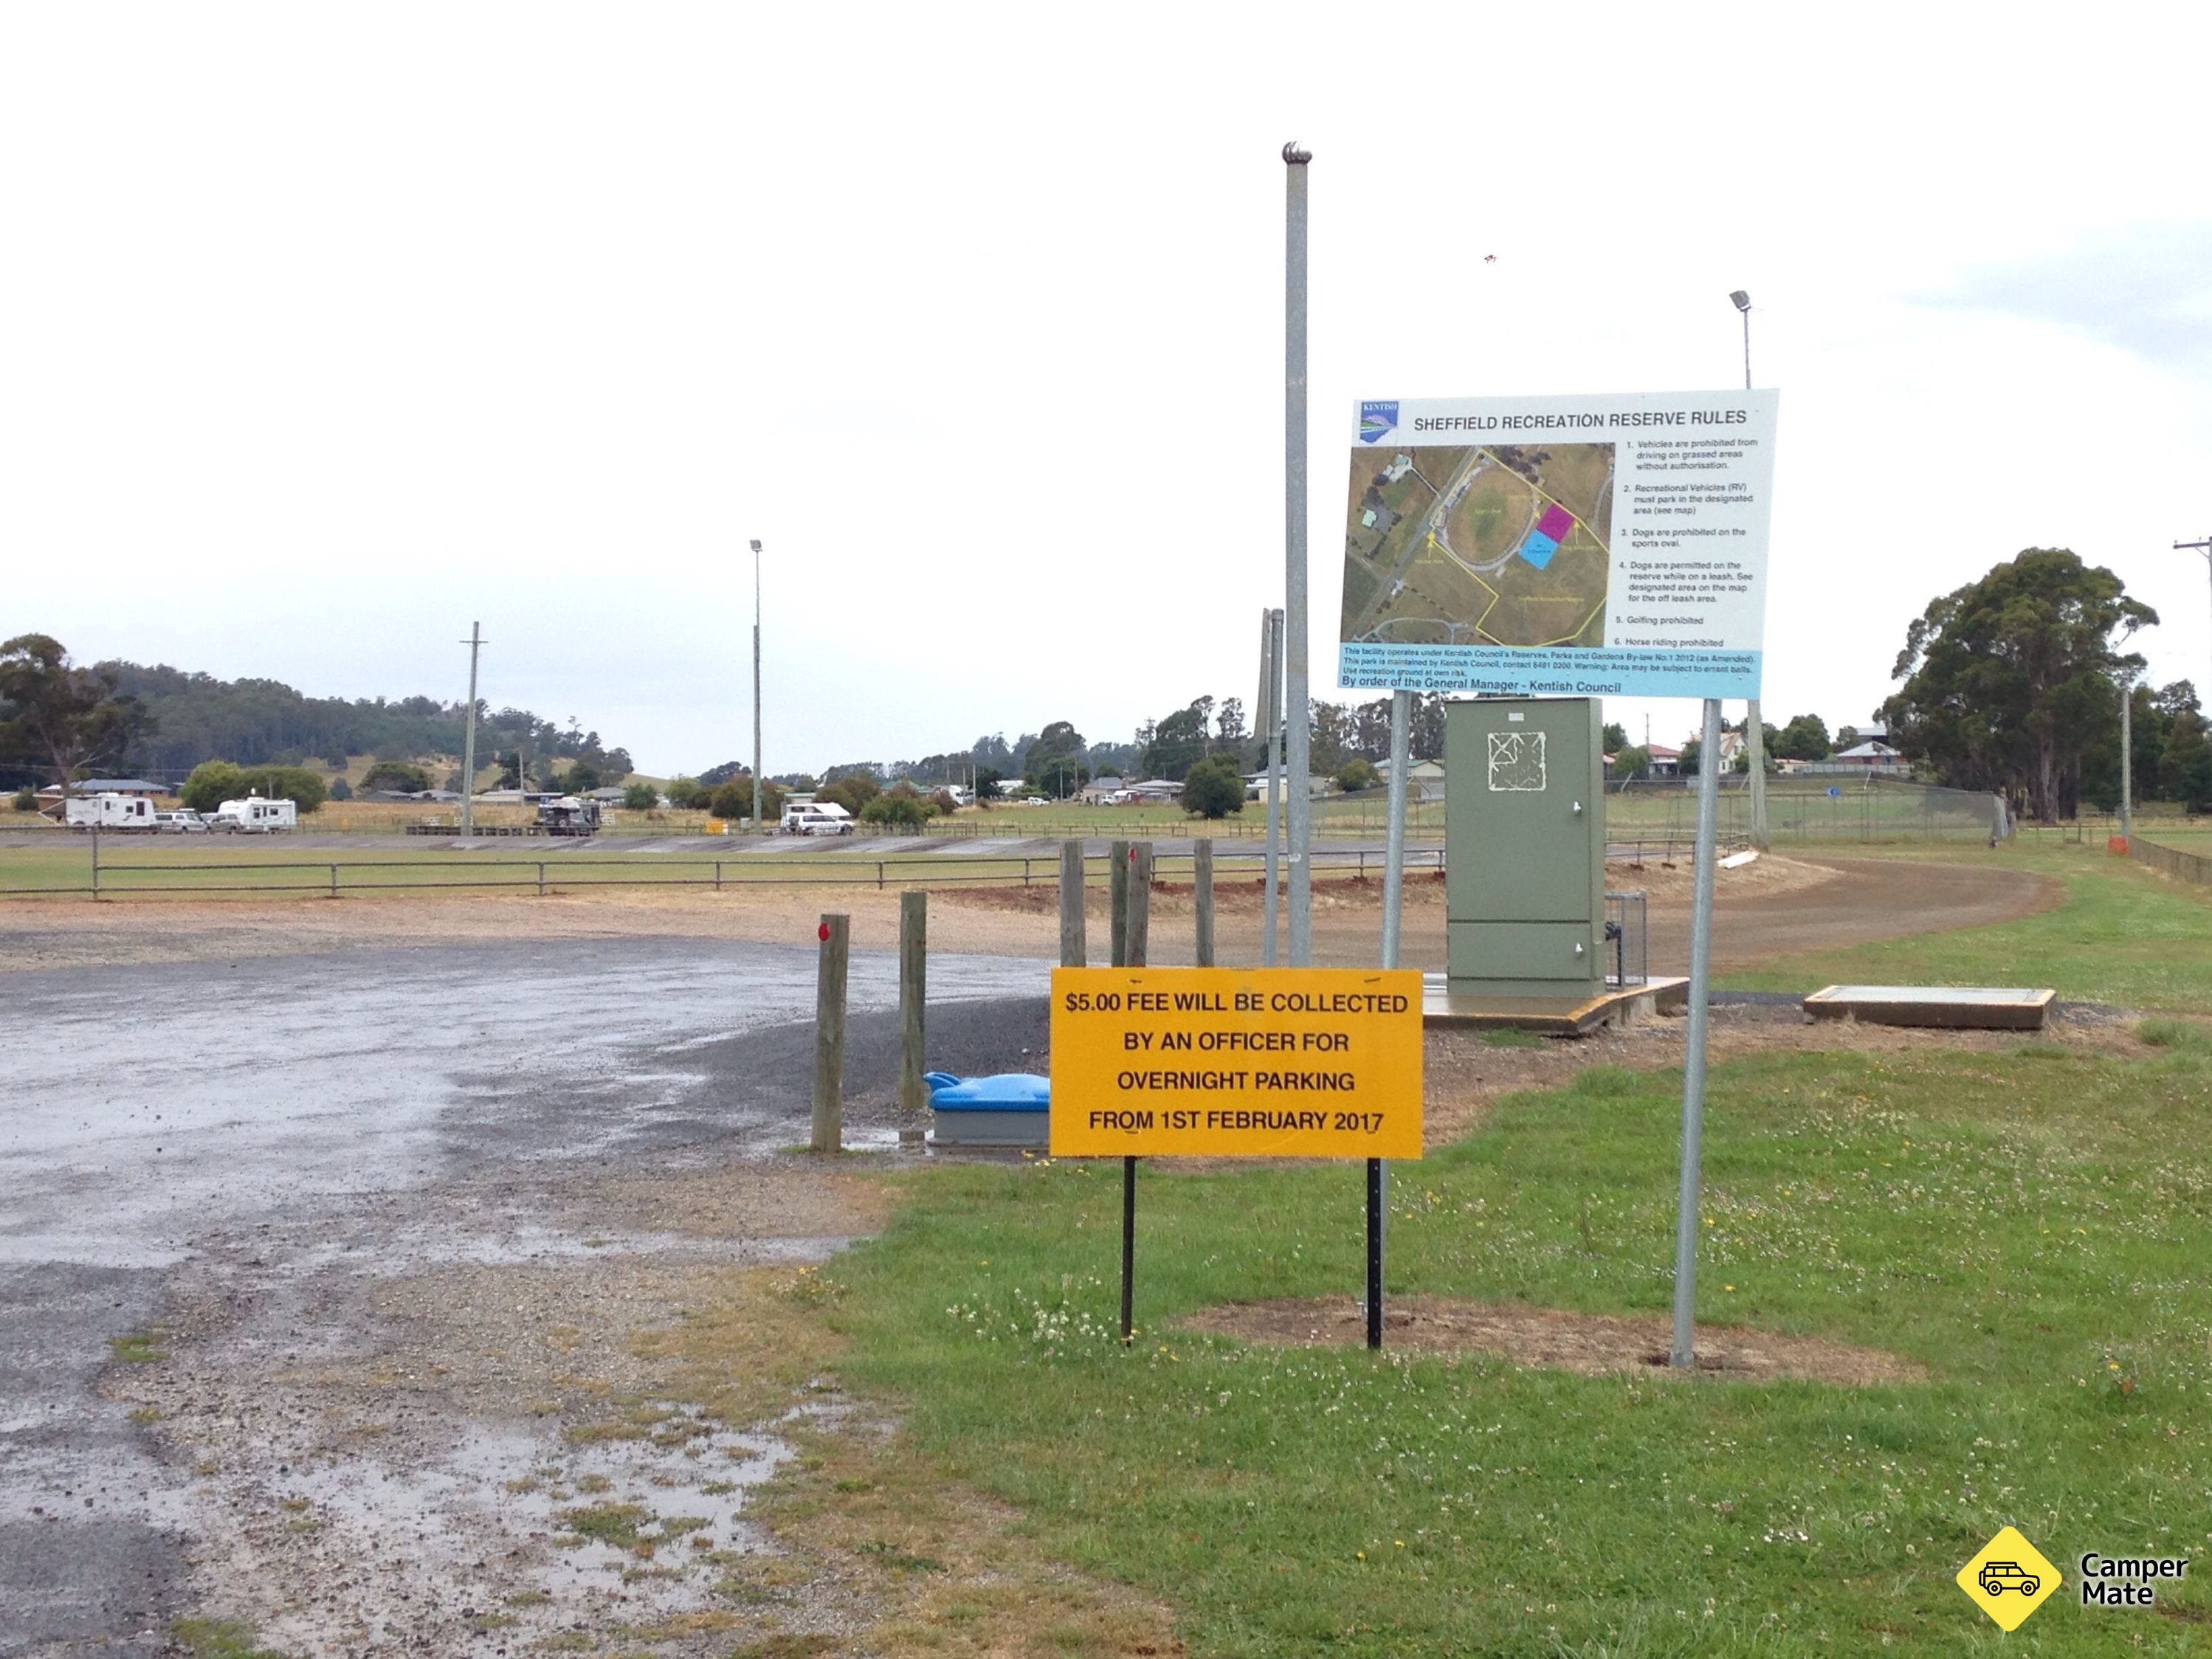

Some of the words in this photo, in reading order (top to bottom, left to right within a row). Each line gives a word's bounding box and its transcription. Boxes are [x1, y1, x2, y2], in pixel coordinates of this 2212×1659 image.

[1415, 416, 1497, 430] SHEFFIELD
[1502, 414, 1604, 429] RECREATION
[1610, 413, 1686, 427] RESERVE
[1691, 410, 1746, 424] RULES
[1691, 439, 1734, 448] prohibited
[1637, 452, 1666, 460] driving
[1682, 450, 1717, 460] grassed
[1729, 483, 1747, 492] (RV)
[1705, 495, 1753, 503] designated
[1654, 507, 1672, 515] (see
[1675, 507, 1696, 515] map)
[1633, 529, 1654, 537] Dogs
[1672, 528, 1716, 537] prohibited
[1630, 562, 1652, 570] Dogs
[1670, 562, 1711, 570] permitted
[1627, 616, 1658, 625] Golfing
[1660, 616, 1703, 625] prohibited
[1653, 638, 1677, 647] riding
[1680, 639, 1723, 647] prohibited
[1362, 648, 1385, 656] facility
[1591, 652, 1624, 661] Gardens
[1627, 653, 1653, 662] By-law
[1696, 655, 1709, 663] (as
[1429, 659, 1438, 667] by
[1440, 659, 1469, 667] Kentish
[1470, 660, 1500, 668] Council,
[1574, 662, 1609, 672] Warning:
[1632, 664, 1647, 672] may
[1663, 664, 1692, 673] subject
[1359, 667, 1395, 675] recreation
[1397, 668, 1423, 676] ground
[1342, 675, 1355, 688] By
[1359, 676, 1387, 686] order
[1391, 677, 1402, 686] of
[1405, 677, 1422, 687] the
[1424, 677, 1467, 689] General
[1471, 679, 1518, 691] Manager
[1529, 680, 1573, 692] Kentish
[1577, 682, 1622, 693] Council
[1066, 992, 1120, 1014] $5.00
[1127, 993, 1168, 1011] FEE
[1174, 993, 1227, 1011] WILL
[1234, 994, 1264, 1012] BE
[1271, 994, 1408, 1013] COLLECTED
[1124, 1032, 1154, 1050] BY
[1160, 1032, 1191, 1050] AN
[1199, 1032, 1295, 1051] OFFICER
[1303, 1033, 1349, 1052] FOR
[1117, 1071, 1249, 1090] OVERNIGHT
[1255, 1072, 1354, 1091] PARKING
[1089, 1111, 1154, 1130] FROM
[1160, 1111, 1200, 1129] 1ST
[1207, 1111, 1327, 1130] FEBRUARY
[1334, 1113, 1383, 1131] 2017
